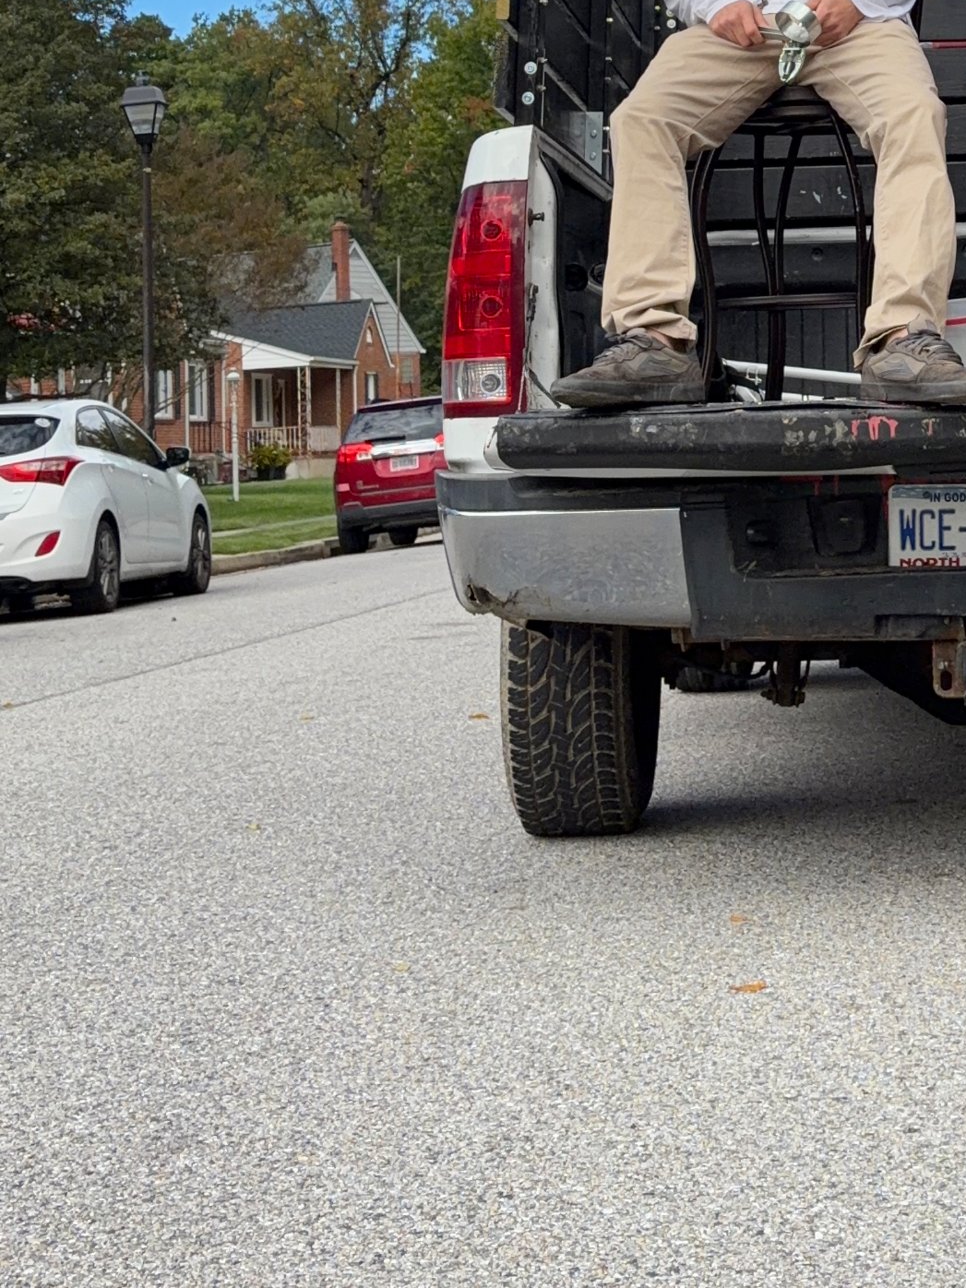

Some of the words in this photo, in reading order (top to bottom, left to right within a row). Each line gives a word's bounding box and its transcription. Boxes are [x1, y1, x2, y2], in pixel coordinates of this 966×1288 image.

[930, 493, 941, 503] IN
[944, 492, 966, 503] GOD
[900, 557, 961, 568] NORTH
